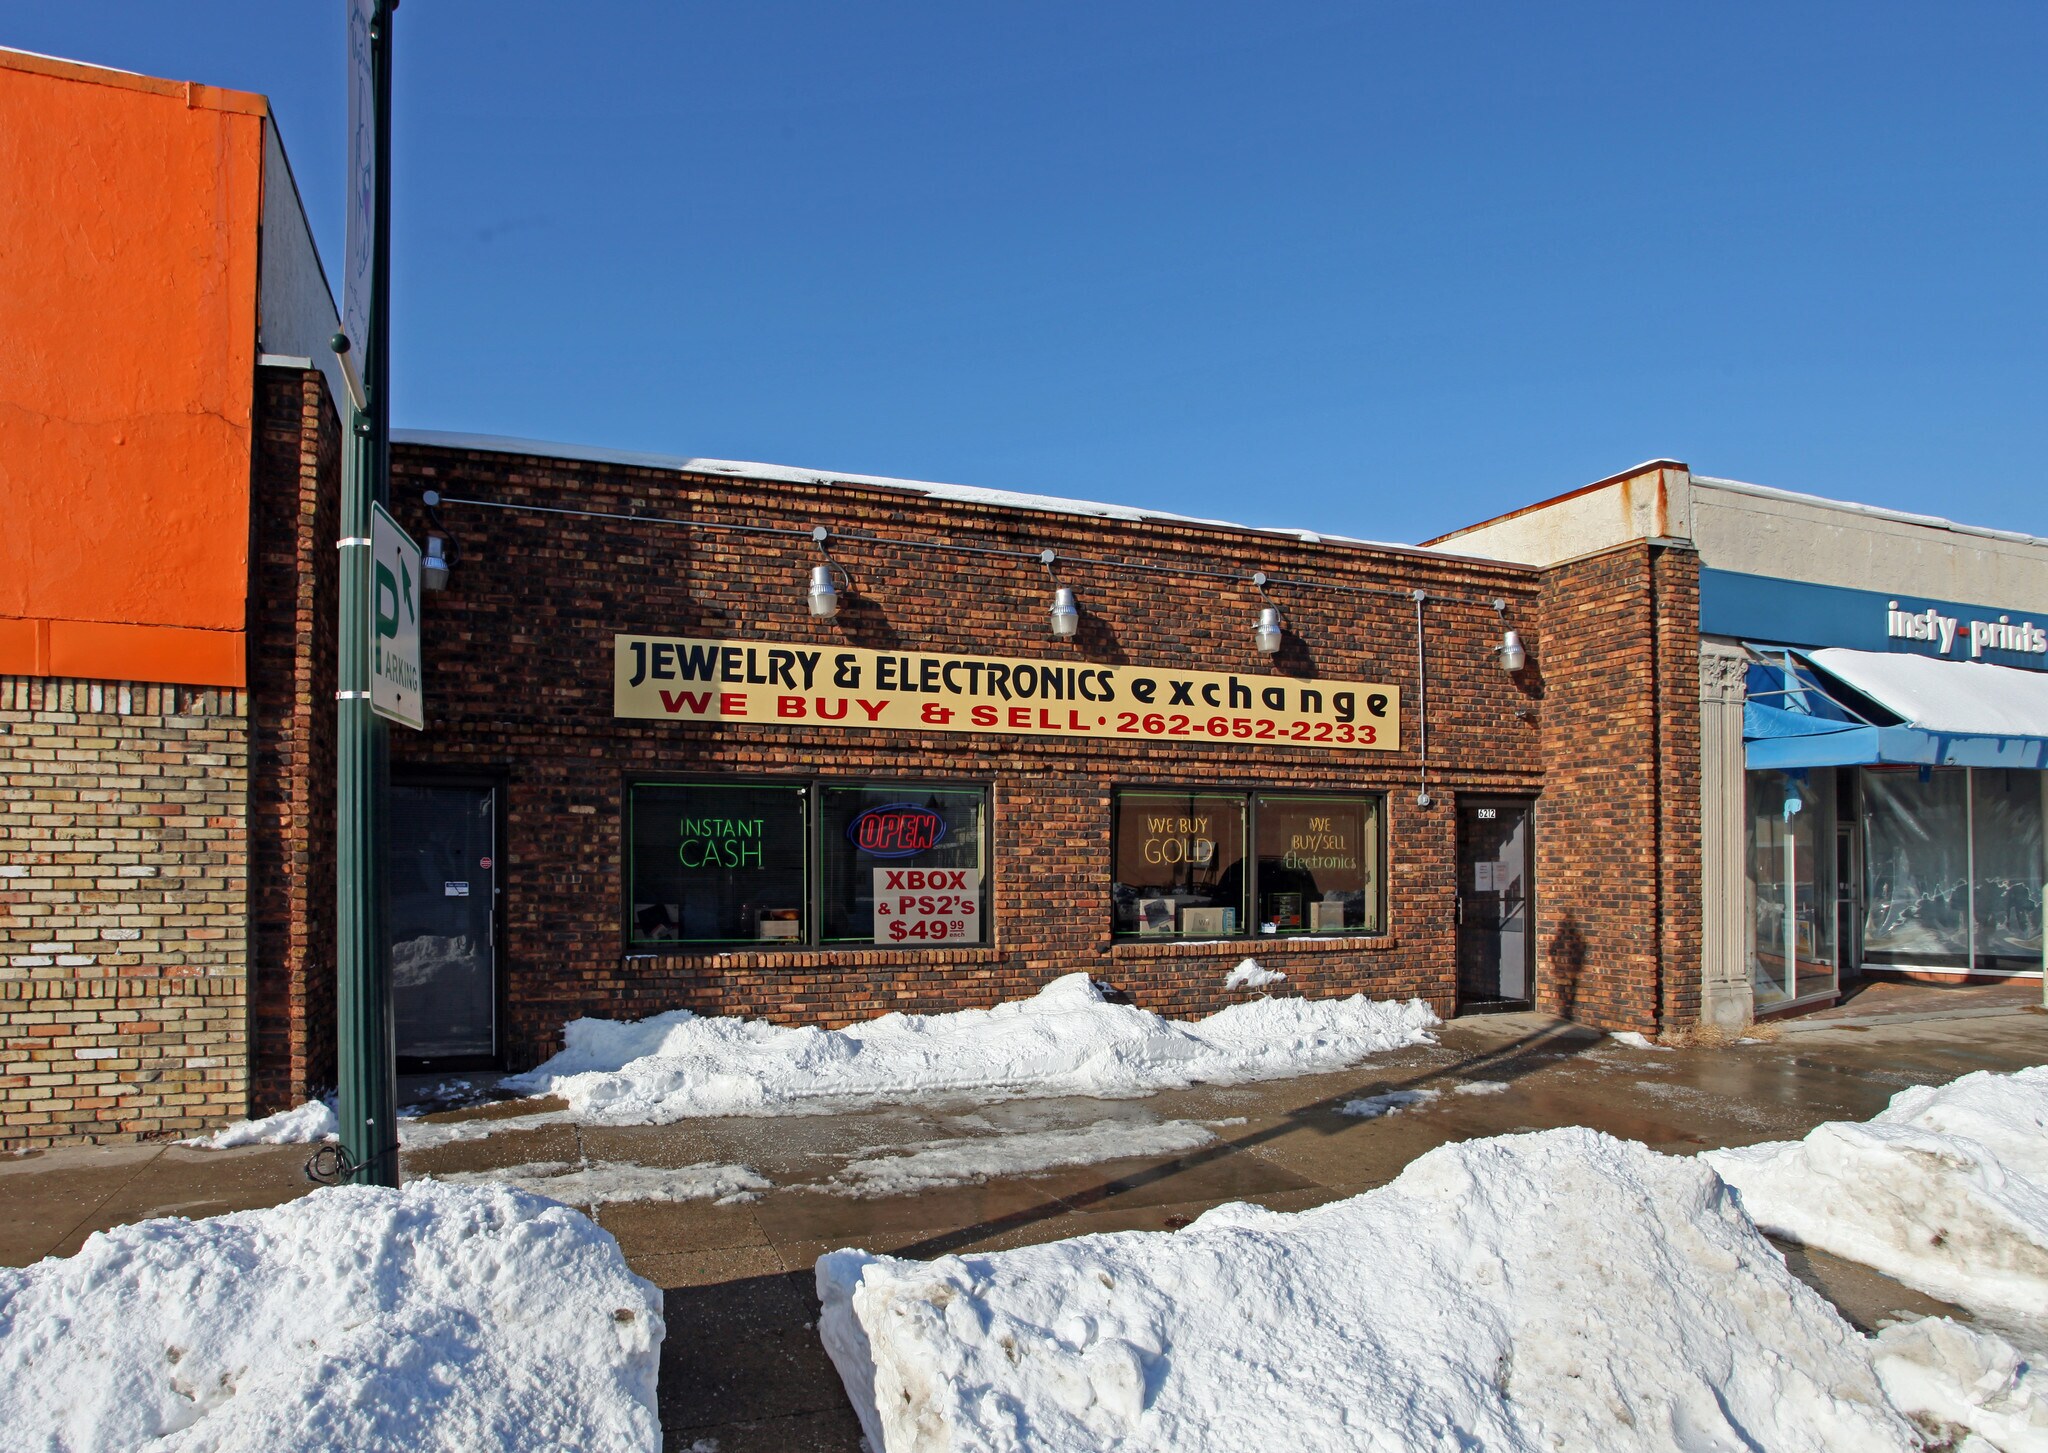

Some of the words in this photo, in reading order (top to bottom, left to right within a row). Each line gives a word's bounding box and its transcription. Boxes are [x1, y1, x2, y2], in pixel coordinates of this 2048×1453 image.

[629, 642, 822, 691] JEWELRY
[834, 654, 861, 689] &
[877, 656, 1115, 702] ELECTRONICS
[1131, 676, 1388, 723] exchange
[658, 690, 748, 716] WE
[777, 696, 890, 721] BUY
[920, 702, 955, 725] &
[971, 705, 1091, 730] SELL
[1116, 712, 1377, 744] 262-652-2233
[1478, 809, 1496, 819] 6212
[680, 818, 764, 838] INSTANT
[860, 814, 936, 849] OPEN
[1148, 817, 1174, 833] WE
[1179, 817, 1208, 833] BUY
[1310, 817, 1331, 832] WE
[680, 839, 763, 868] CASH
[1144, 838, 1213, 864] GOLD
[1284, 850, 1357, 869] Electronics
[885, 871, 967, 890] XBOX
[878, 902, 892, 915] &
[889, 920, 948, 942] $49
[949, 920, 965, 930] 99
